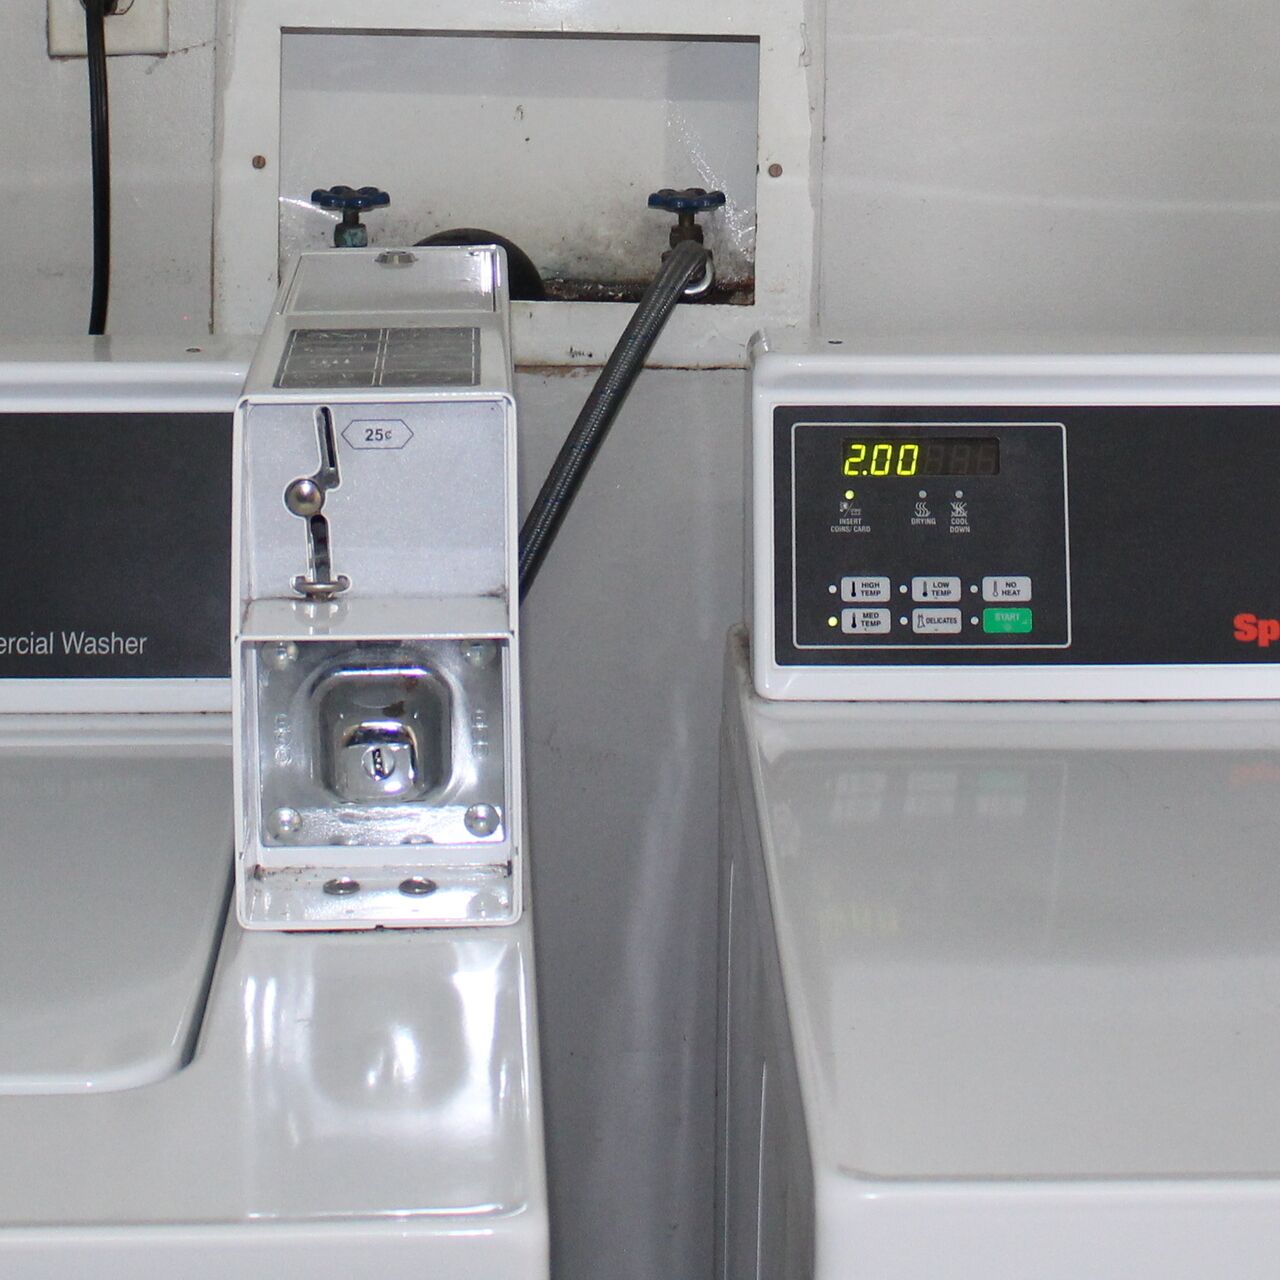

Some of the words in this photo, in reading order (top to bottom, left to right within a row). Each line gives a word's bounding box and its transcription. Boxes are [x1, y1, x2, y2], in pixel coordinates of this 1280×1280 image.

[364, 428, 393, 442] 25¢
[843, 443, 920, 477] 2.00
[839, 517, 862, 525] INSERT
[910, 517, 937, 526] DRYING
[950, 517, 969, 525] COOL
[949, 526, 971, 534] DOWN
[861, 581, 881, 589] HIGH
[932, 581, 950, 589] LOW
[1005, 581, 1018, 589] NO
[860, 589, 882, 597] TEMP
[931, 589, 952, 597] TEMP
[1001, 589, 1022, 597] HEAT
[862, 611, 880, 619] MED
[860, 619, 882, 628] TEMP
[925, 617, 958, 625] DELICATES
[62, 631, 148, 655] Washer
